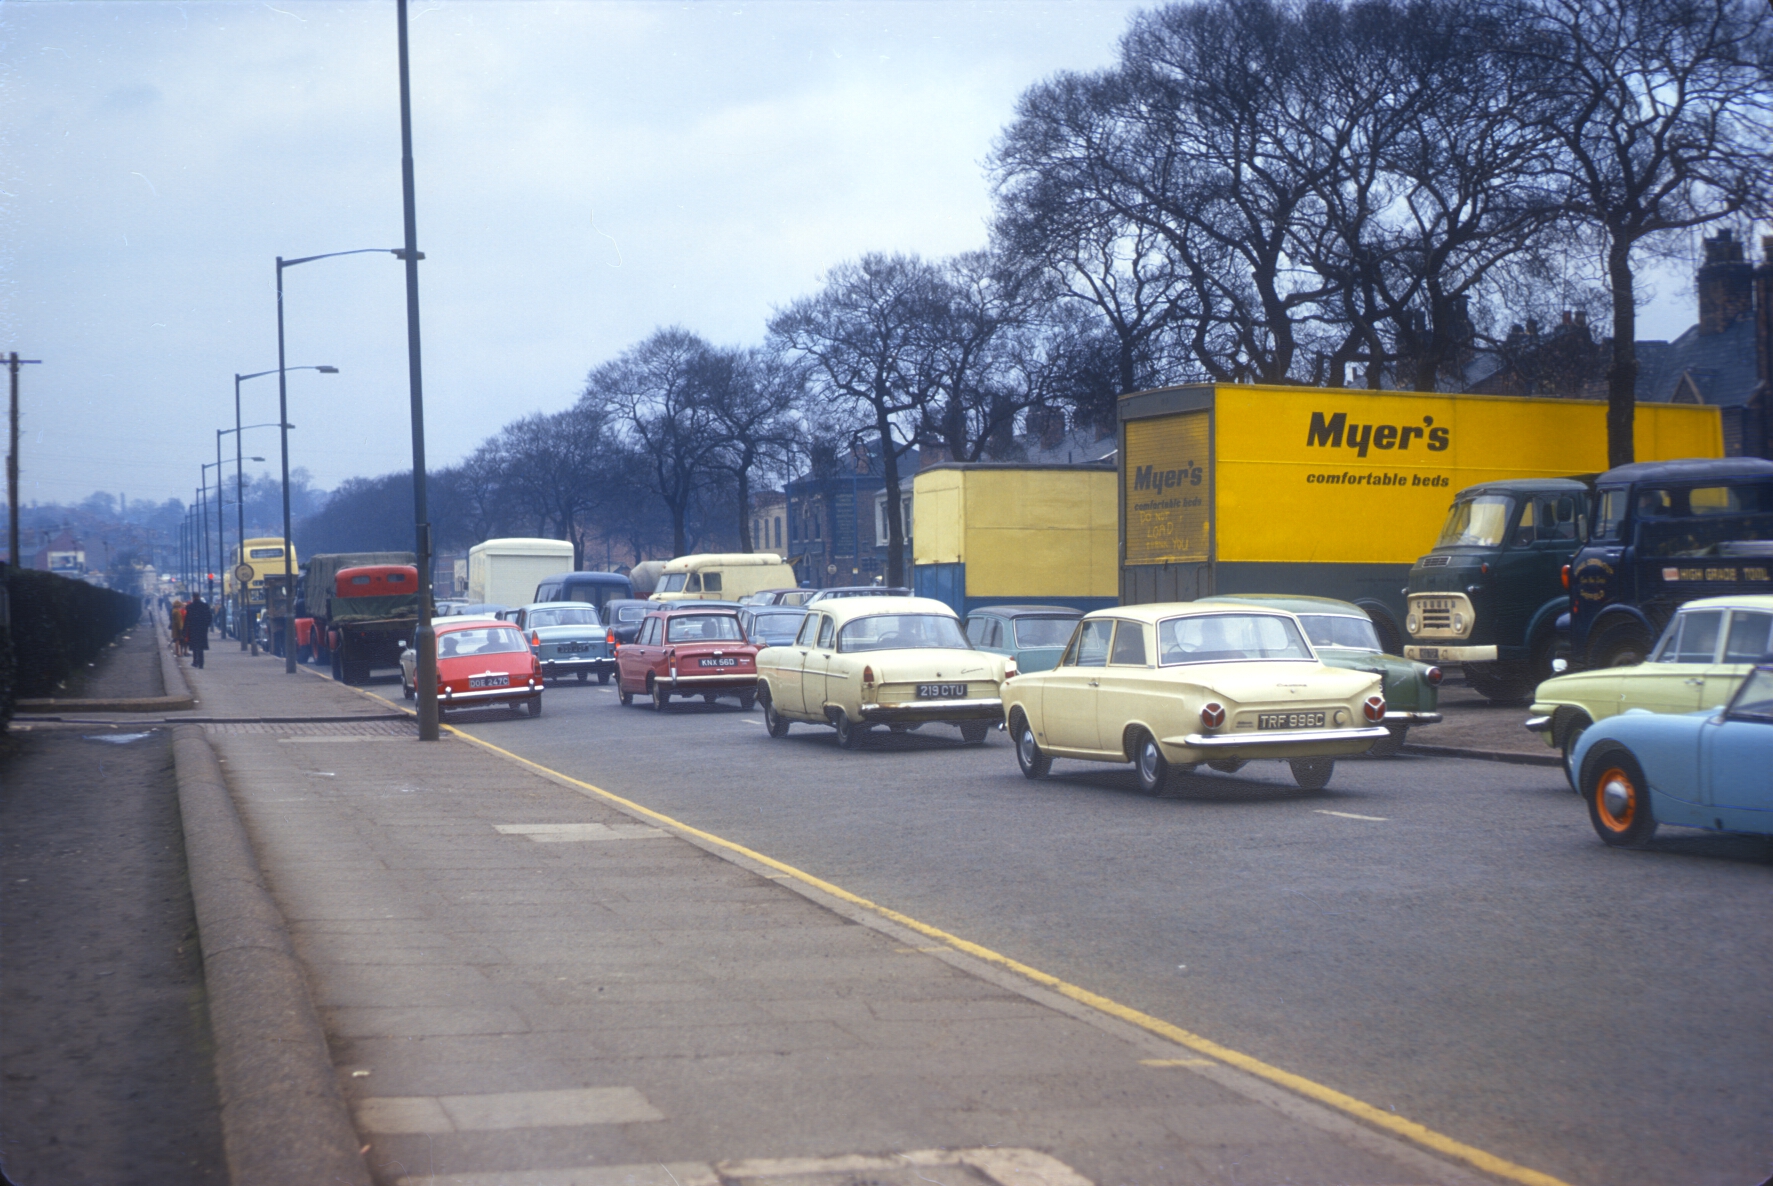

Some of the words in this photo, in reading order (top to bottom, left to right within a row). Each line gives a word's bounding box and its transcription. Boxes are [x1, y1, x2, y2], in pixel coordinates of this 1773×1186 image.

[1306, 411, 1450, 458] Myer's
[1134, 460, 1203, 495] Myer's
[1306, 472, 1407, 486] comfortable
[1411, 474, 1450, 487] beds
[1134, 499, 1181, 511] comfortable
[1147, 521, 1174, 538] LOAD
[1680, 568, 1704, 580] HIGH
[1705, 568, 1738, 581] GRADE
[920, 685, 940, 696] 219
[941, 685, 964, 696] CTU
[1260, 715, 1287, 728] TRF
[1288, 713, 1324, 727] 996C
